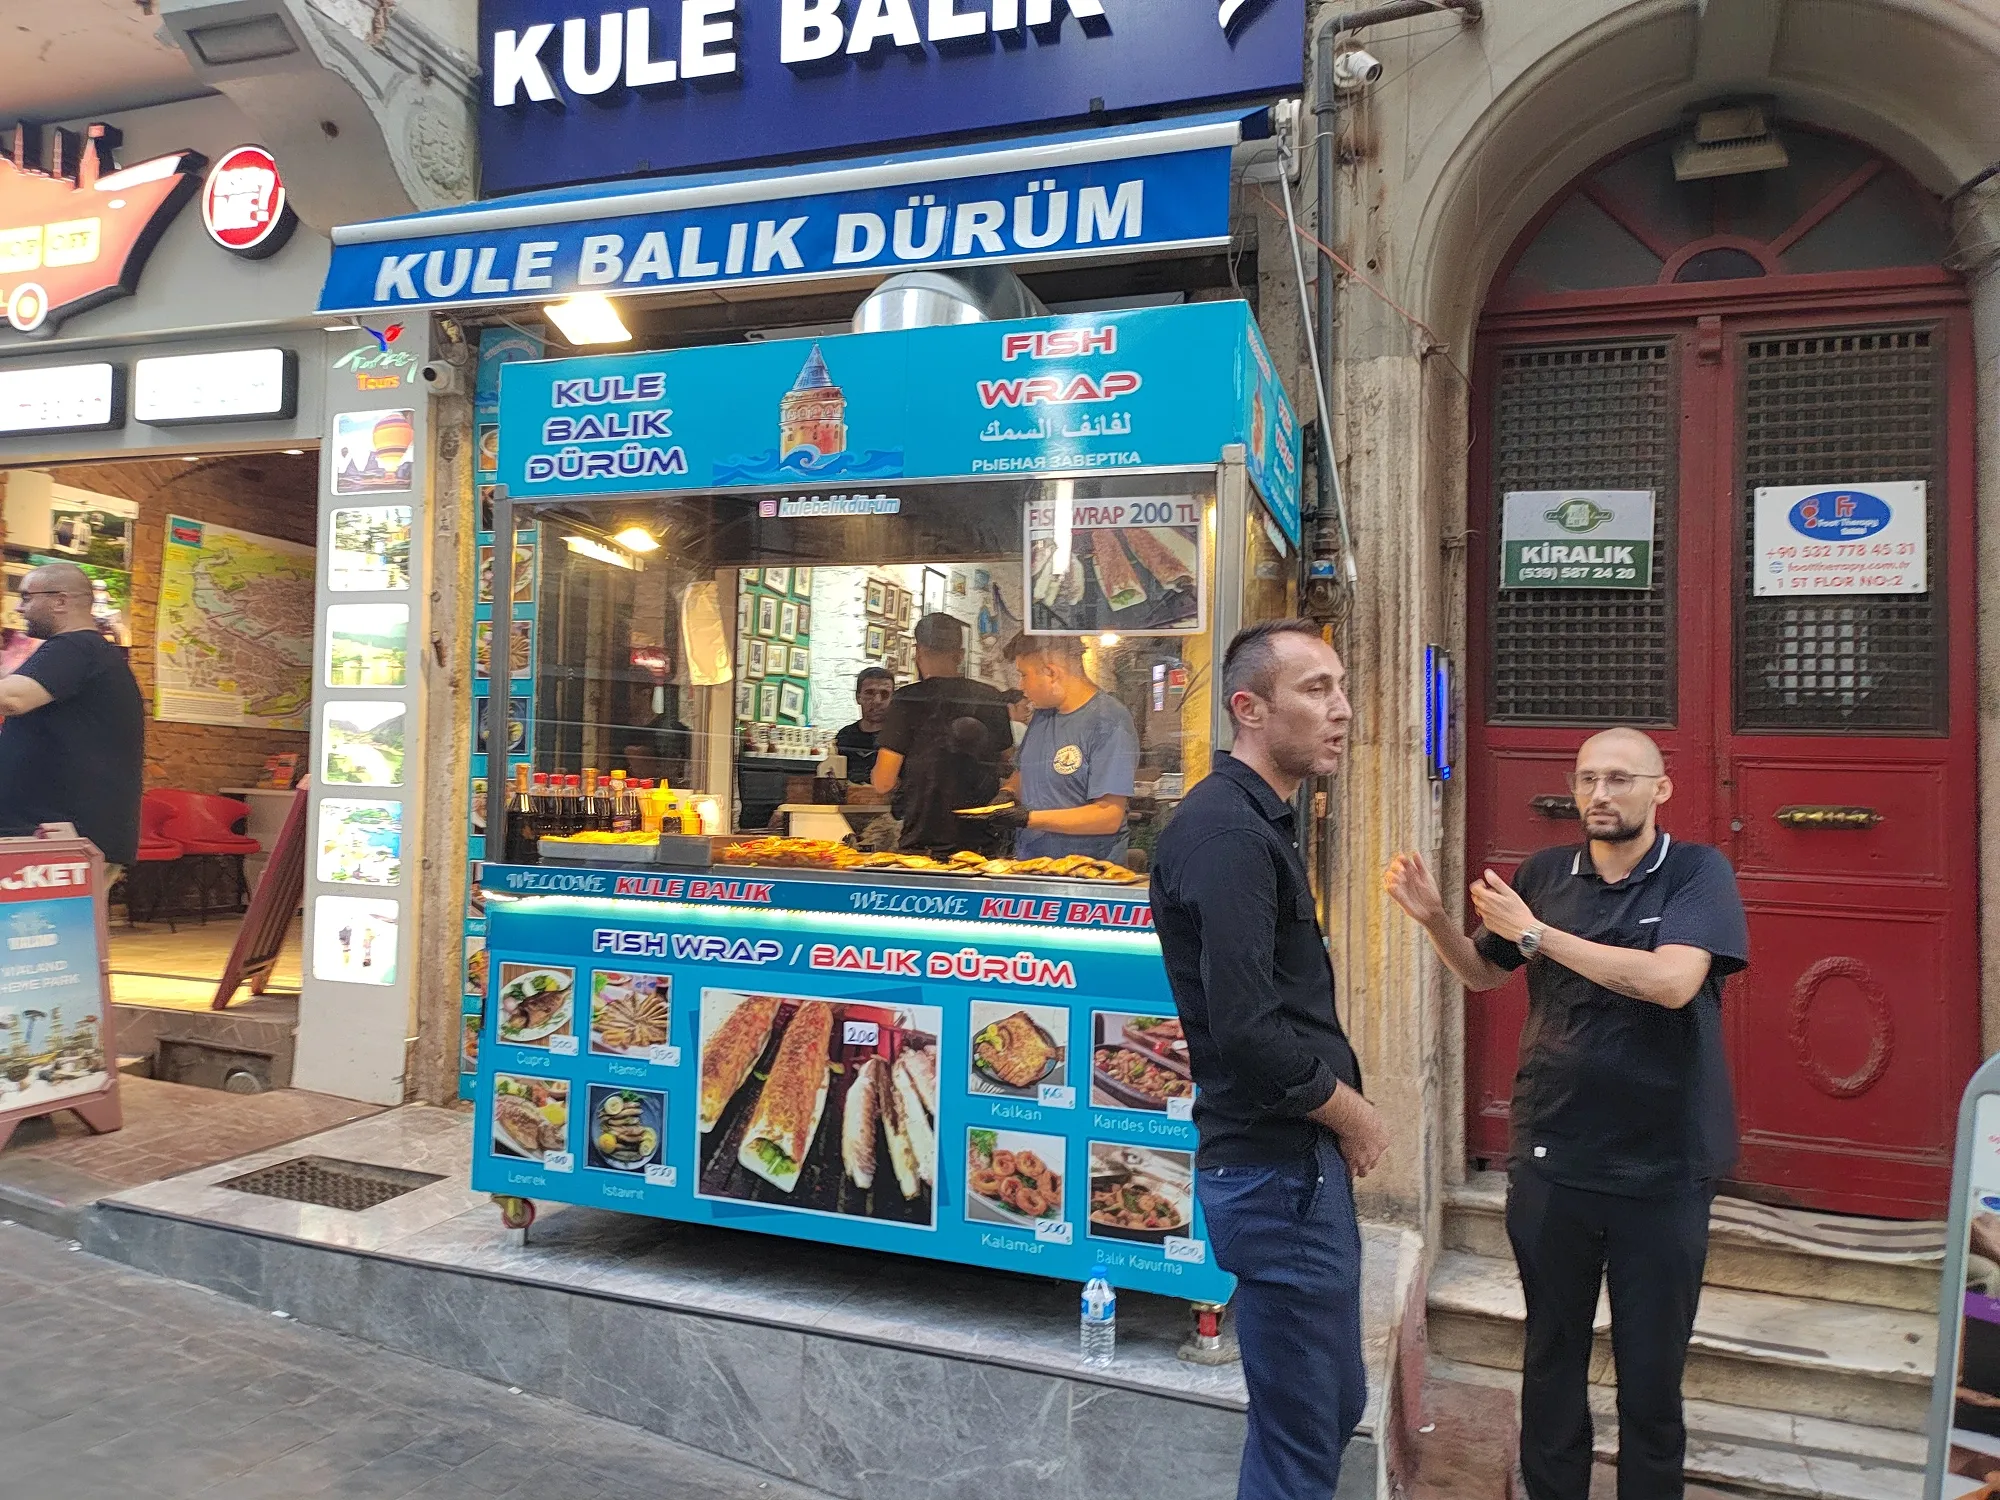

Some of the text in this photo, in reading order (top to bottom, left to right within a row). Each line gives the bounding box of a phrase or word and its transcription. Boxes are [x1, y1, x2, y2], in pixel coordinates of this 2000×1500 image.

[493, 0, 737, 107] KULE
[374, 178, 1144, 301] KULE BALIK DÜRÜM
[1002, 326, 1117, 361] FISH
[552, 373, 666, 408] KULE
[976, 370, 1142, 409] WRAP
[543, 409, 673, 446] BALIK
[979, 418, 1052, 442] السمك
[525, 442, 689, 483] DÜRÜM
[972, 450, 1142, 472] РЫБНАЯ ЗАВЕРТКА
[1028, 502, 1201, 527] FIS WRAP 200 TL
[1520, 541, 1635, 565] KİRALIK
[506, 871, 776, 903] WELCOME KULE BALIK
[850, 890, 969, 916] WELCOME
[978, 897, 1063, 923] KULE
[592, 928, 668, 957] FISH
[670, 933, 784, 965] WRAP
[809, 943, 922, 977] BALIK
[926, 947, 1077, 989] DÜRÜM
[847, 1026, 877, 1043] 200
[608, 1061, 648, 1078] Hamsi
[991, 1102, 1042, 1121] Kalkan
[1093, 1113, 1145, 1133] Karides
[981, 1232, 1046, 1255] Kalamar
[1128, 1254, 1184, 1276] Kavurma
